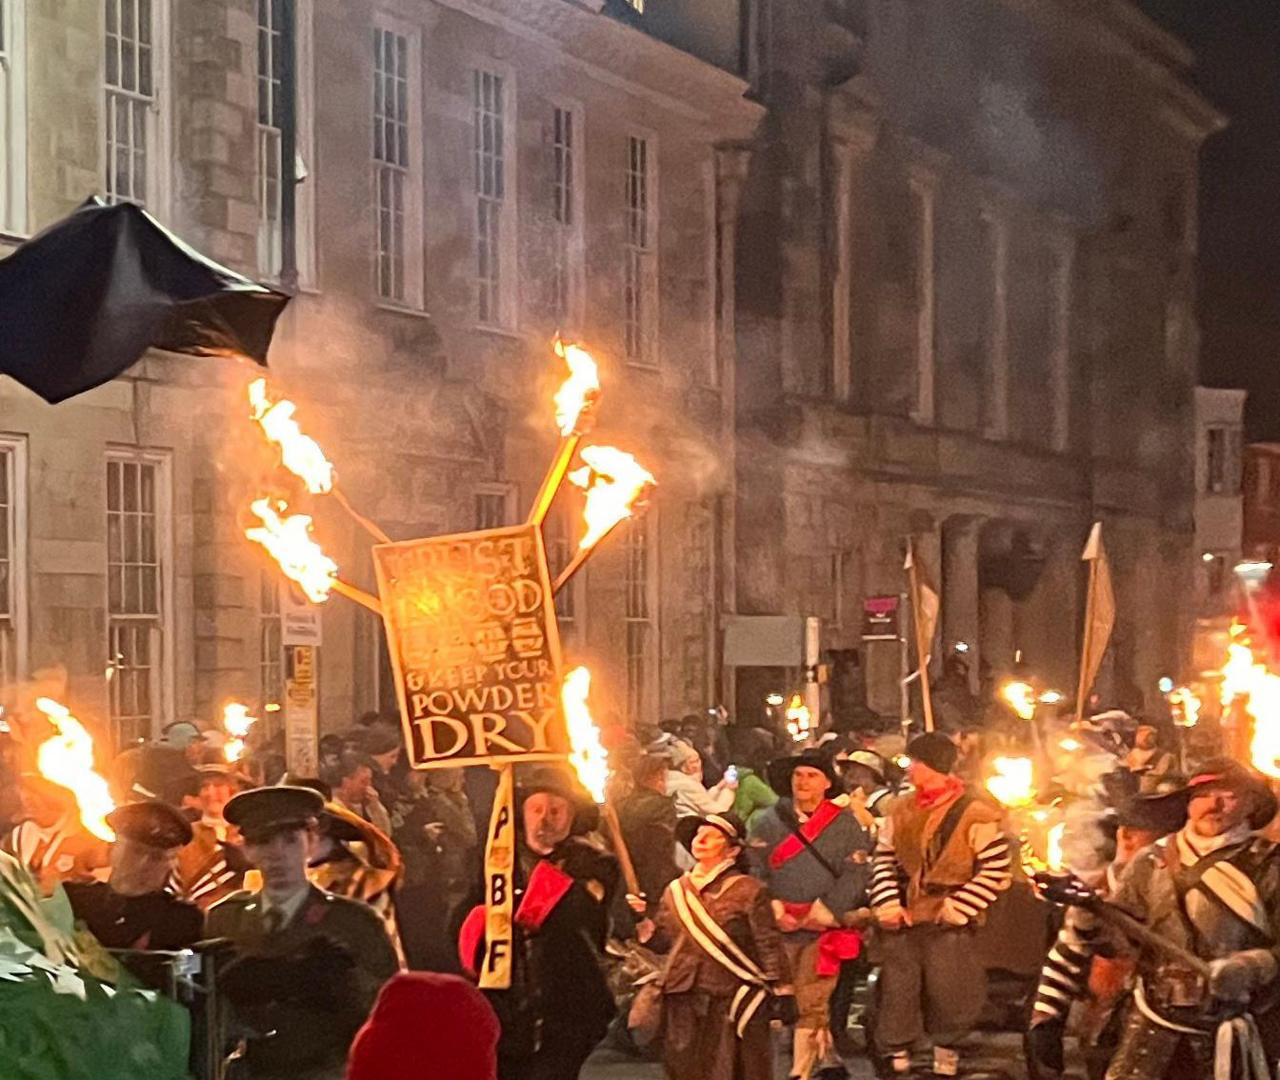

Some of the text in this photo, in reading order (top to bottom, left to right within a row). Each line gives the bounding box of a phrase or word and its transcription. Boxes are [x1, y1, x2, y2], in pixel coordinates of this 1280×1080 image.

[429, 666, 488, 689] KEEP
[495, 659, 551, 680] YOUR
[412, 682, 554, 718] POWDER
[414, 708, 556, 760] DRY
